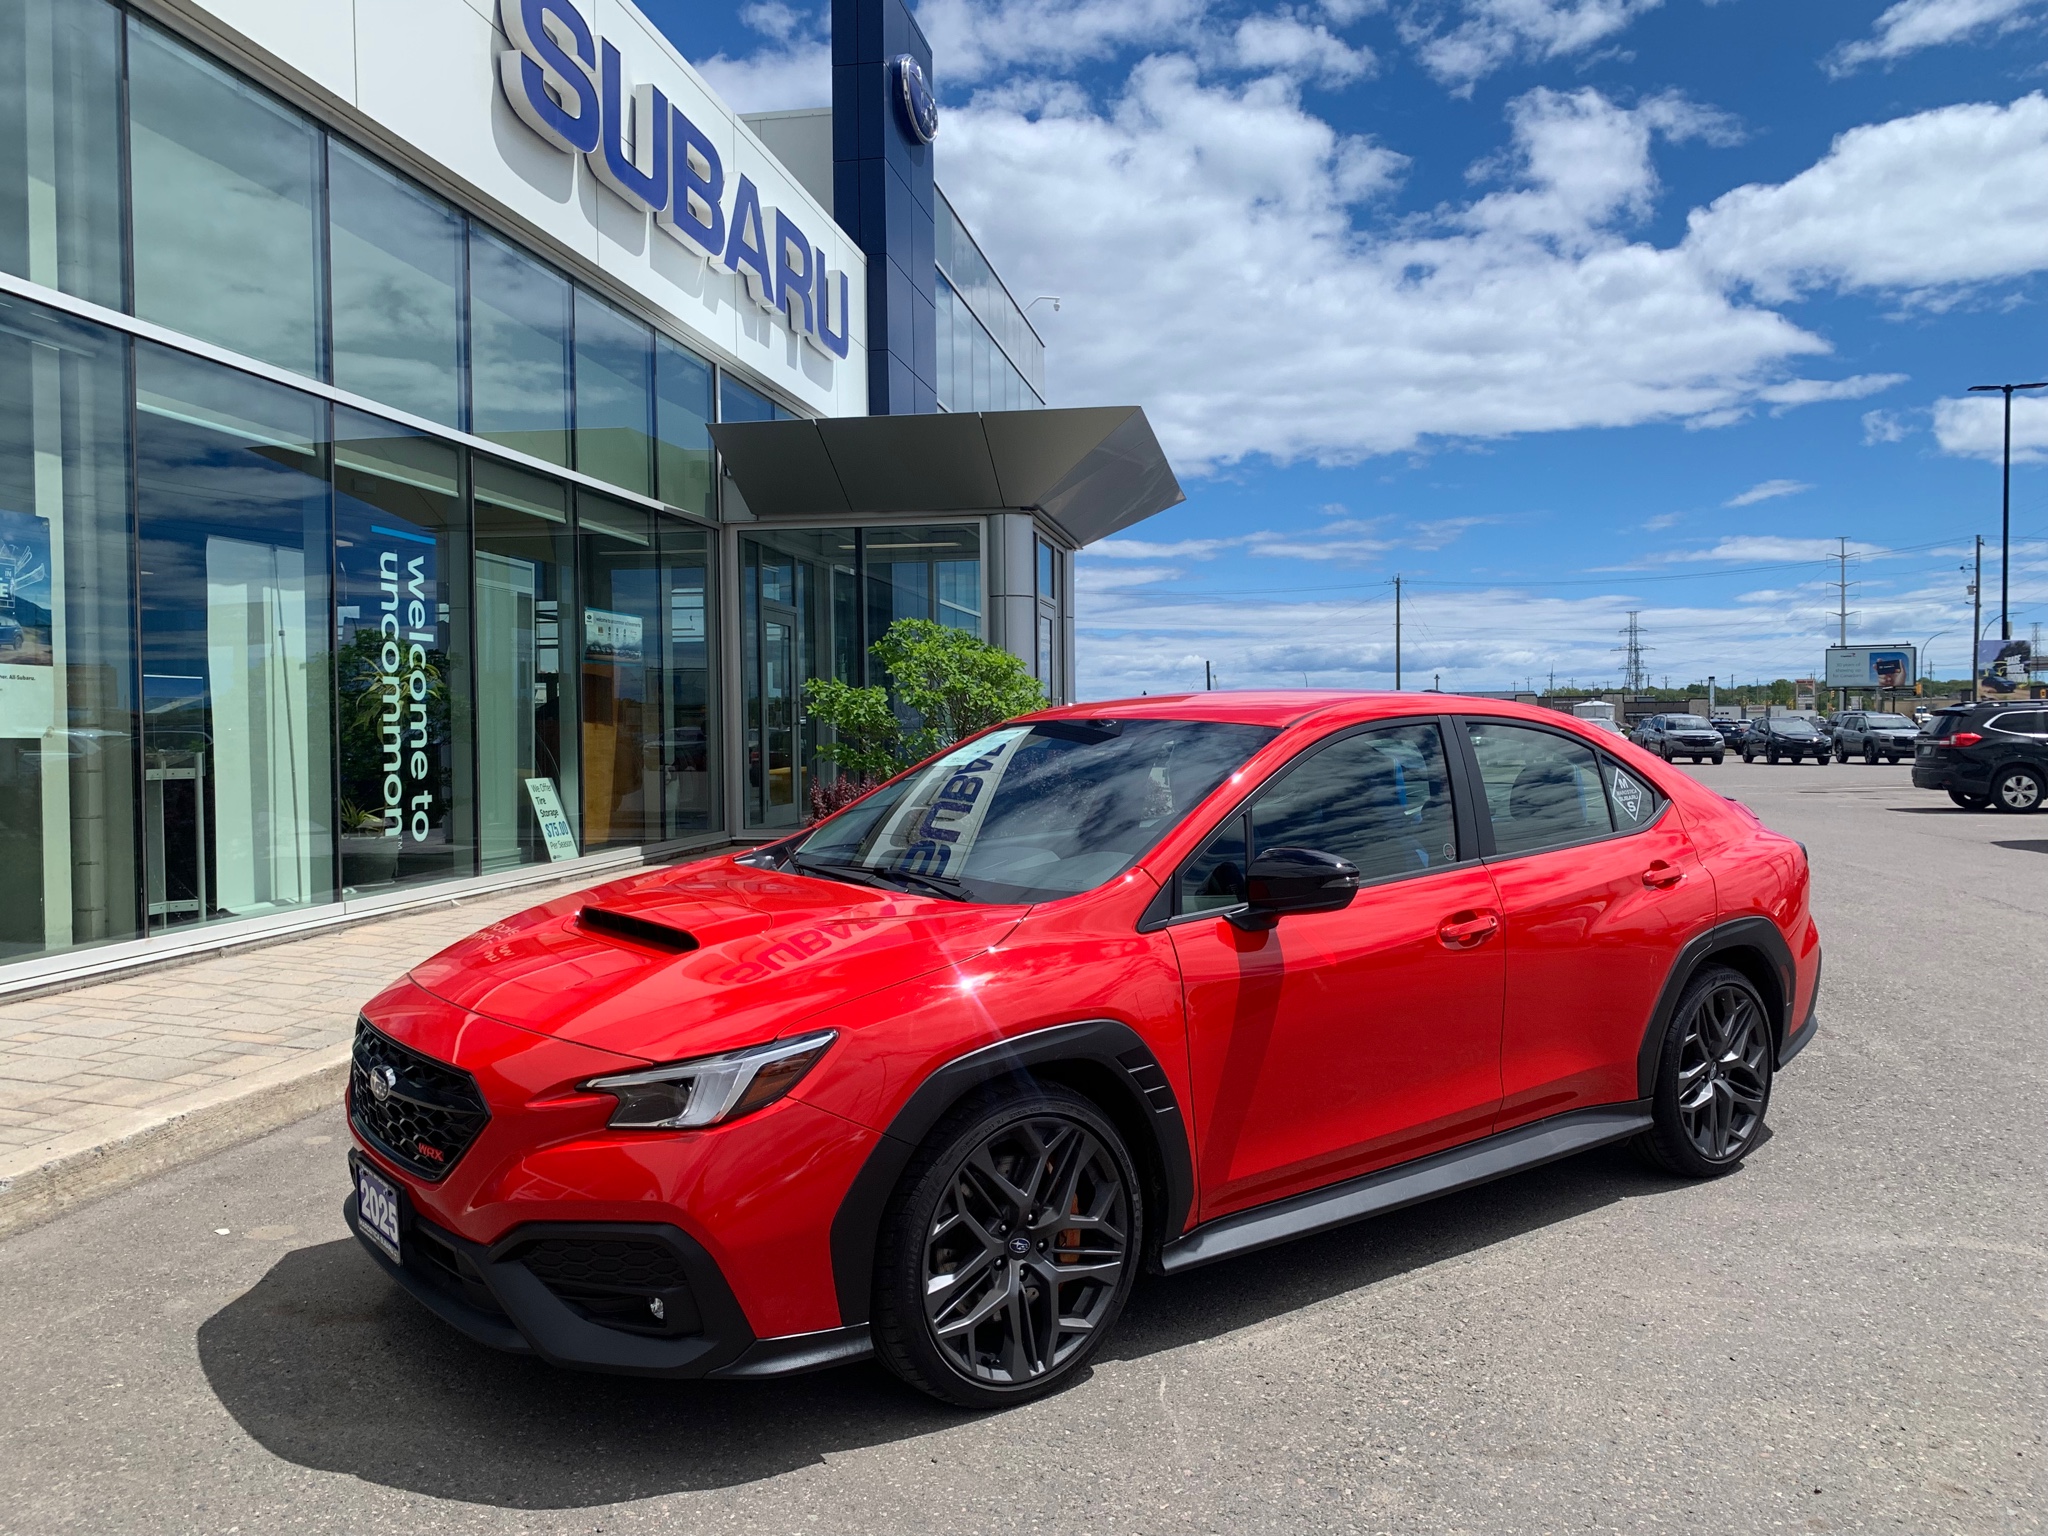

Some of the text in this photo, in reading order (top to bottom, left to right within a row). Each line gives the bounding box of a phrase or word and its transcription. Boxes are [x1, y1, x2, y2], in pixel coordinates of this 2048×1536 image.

[503, 0, 849, 360] SUBARU
[380, 551, 403, 837] uncommon
[408, 555, 434, 842] welcome to
[531, 783, 552, 793] We Offer
[1618, 778, 1629, 789] M
[535, 796, 547, 805] Tire
[1618, 794, 1639, 802] SUBARU
[1627, 801, 1637, 813] S
[540, 809, 559, 818] Storage
[545, 820, 569, 838] $75.00
[550, 840, 573, 849] Per Season
[418, 1142, 444, 1162] WRX
[360, 1179, 398, 1243] 2025
